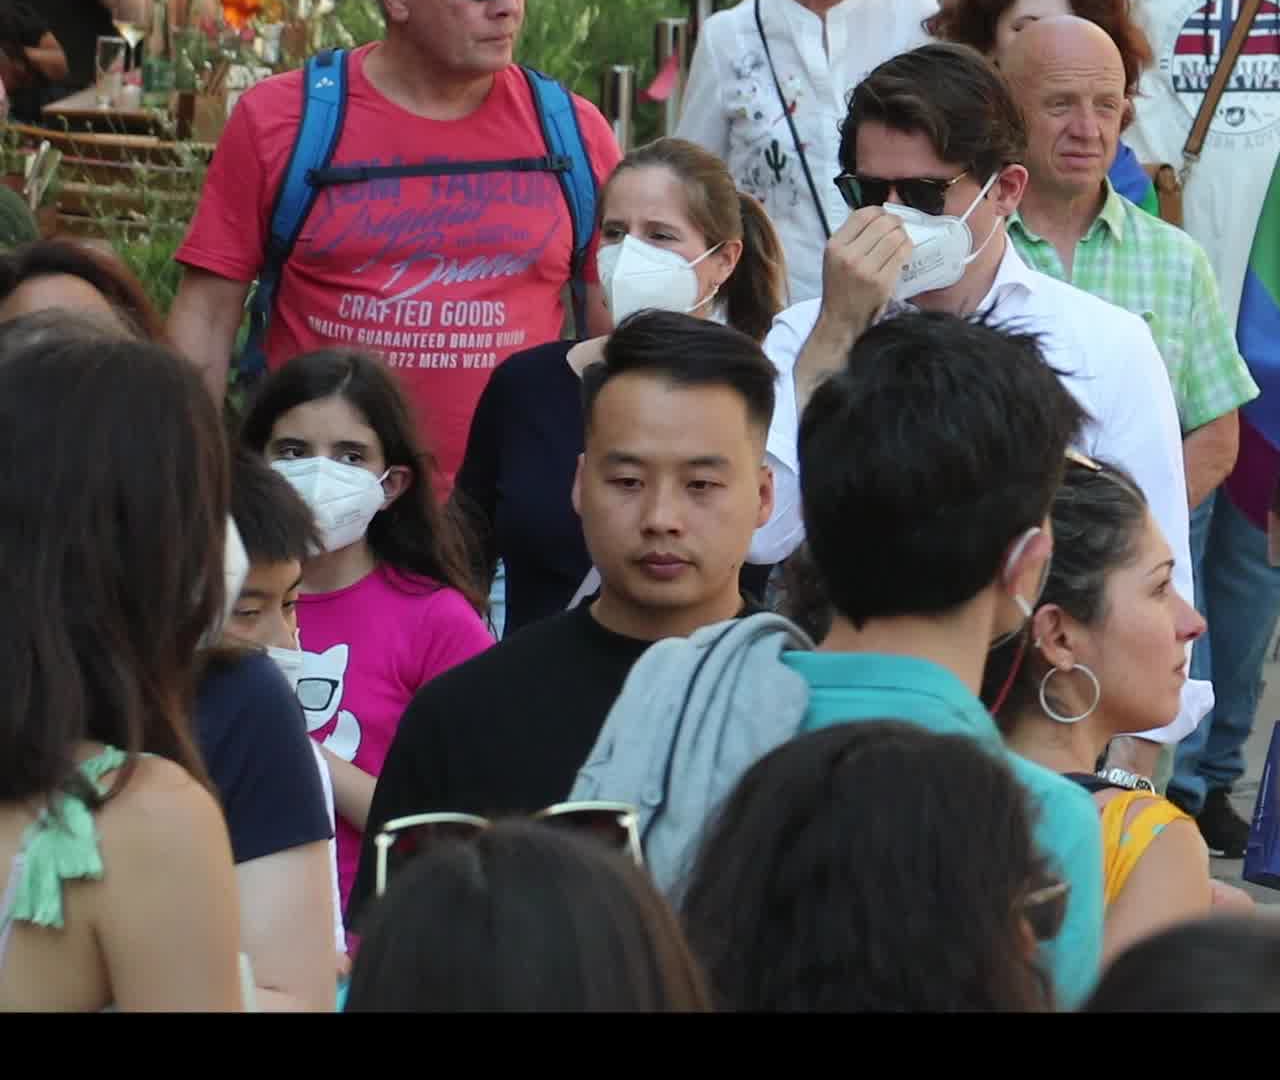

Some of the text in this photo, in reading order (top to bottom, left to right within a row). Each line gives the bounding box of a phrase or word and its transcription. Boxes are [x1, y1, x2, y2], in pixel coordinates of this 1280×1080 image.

[338, 294, 505, 327] CRAFTED GOODS
[357, 327, 444, 349] GUARANTEED
[450, 332, 492, 349] BRAND
[419, 351, 458, 369] MENS
[462, 352, 497, 369] WEAR
